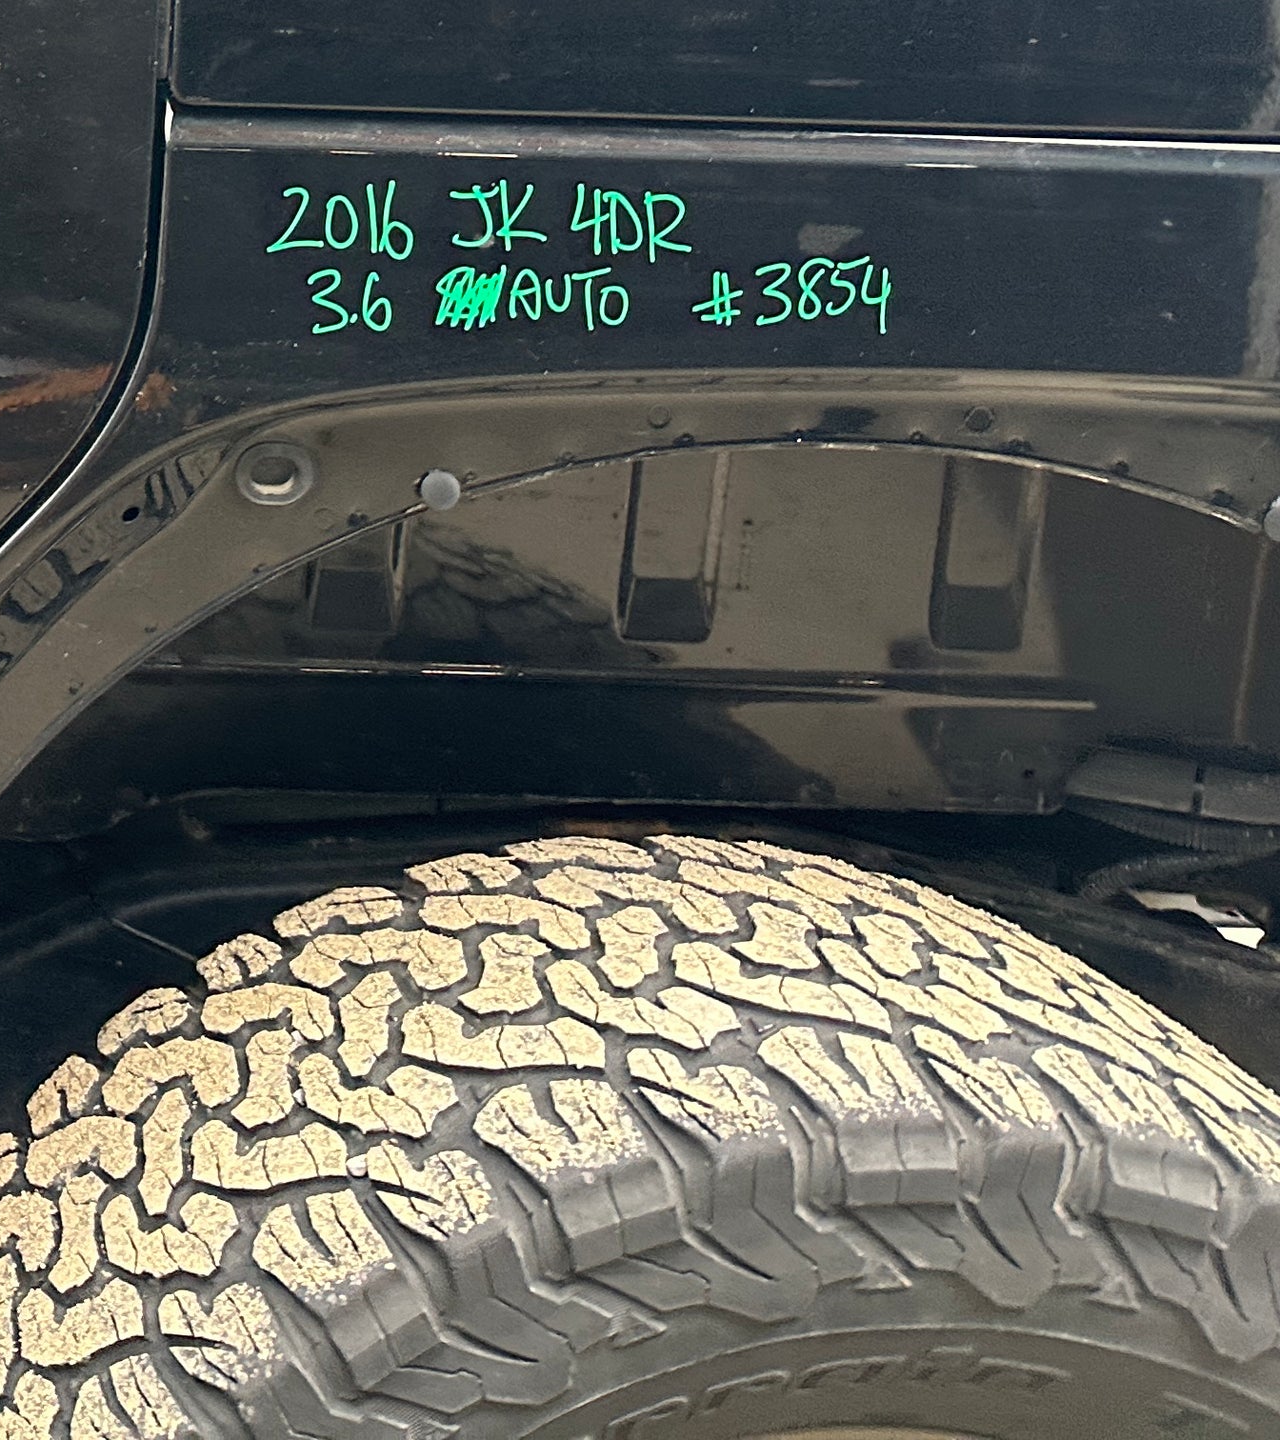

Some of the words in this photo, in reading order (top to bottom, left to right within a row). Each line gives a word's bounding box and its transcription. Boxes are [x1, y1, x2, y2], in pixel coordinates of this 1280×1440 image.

[266, 180, 415, 260] 2016
[449, 180, 549, 250] JK
[571, 182, 694, 263] 4DR
[307, 268, 394, 333] 3.6
[508, 267, 630, 332] AUTO
[692, 255, 892, 334] #3854
